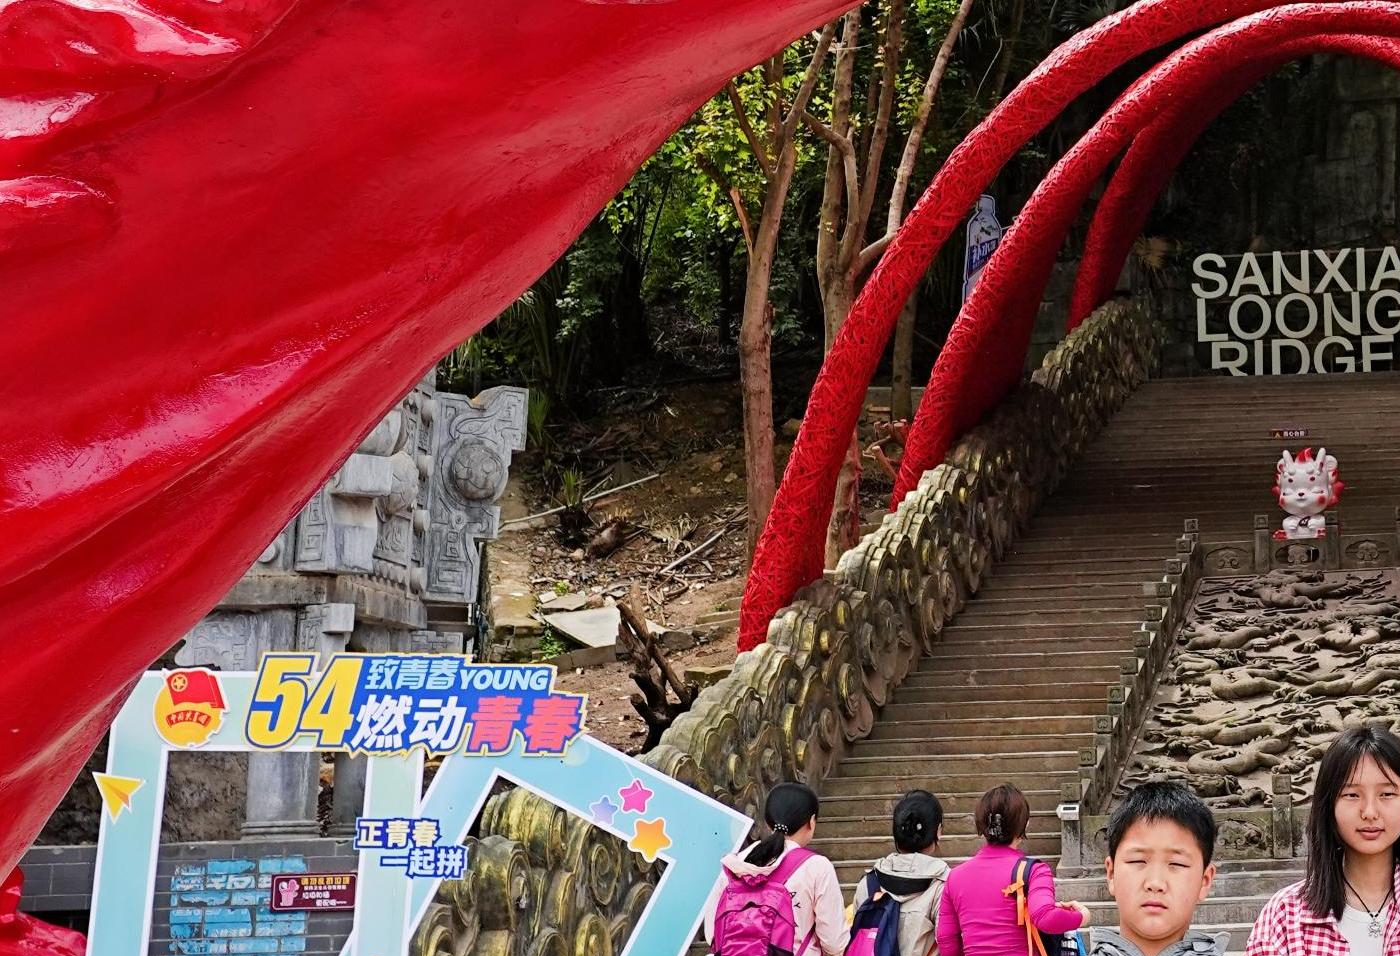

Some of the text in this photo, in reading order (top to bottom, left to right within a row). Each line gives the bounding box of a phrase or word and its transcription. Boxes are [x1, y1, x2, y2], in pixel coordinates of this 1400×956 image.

[1211, 335, 1395, 377] RIDGE
[365, 659, 549, 692] 致青春 YOUNG
[248, 658, 364, 746] 54
[351, 694, 579, 753] 燃动青春
[356, 819, 438, 848] 正青春
[381, 847, 463, 877] 一起拼
